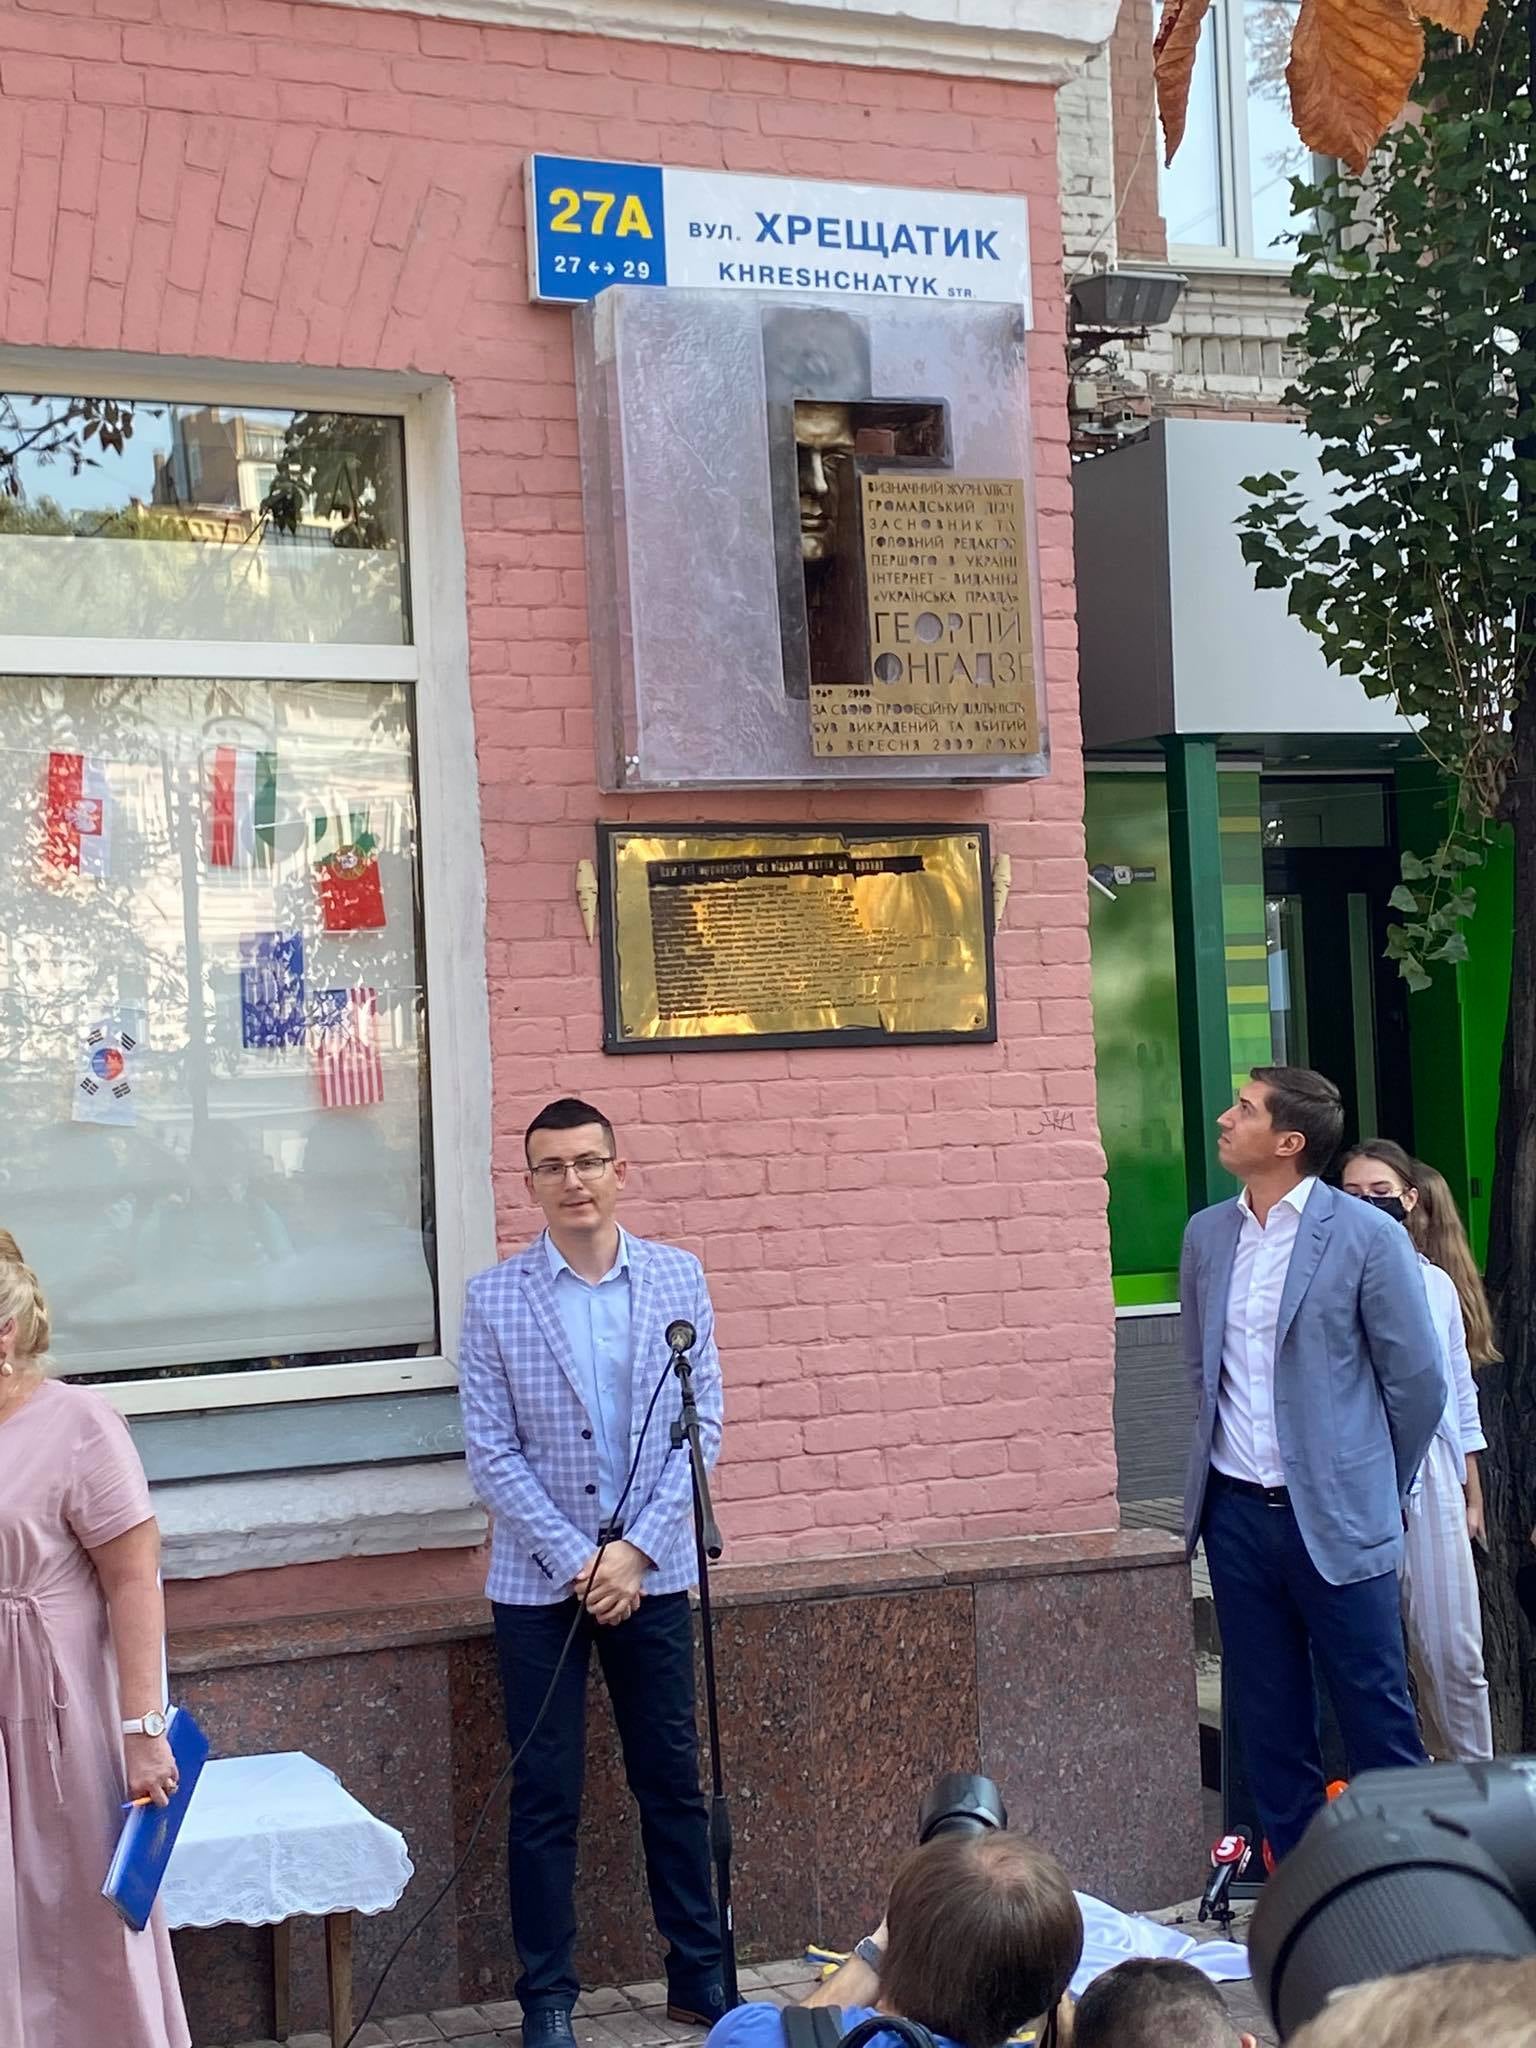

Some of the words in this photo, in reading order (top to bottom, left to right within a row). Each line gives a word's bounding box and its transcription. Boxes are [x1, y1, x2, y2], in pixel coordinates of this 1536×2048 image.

[548, 188, 653, 239] 27А
[689, 223, 741, 241] ВУЛ.
[755, 211, 1000, 260] ХРЕЩАТИК
[554, 256, 580, 273] 27
[623, 261, 650, 279] 29
[719, 263, 937, 295] KHRESHCHATYK
[868, 482, 943, 495] ВИЗНАЧНИЙ
[868, 500, 974, 514] ГРОМАДСЬКИЙ
[870, 519, 983, 531] ЗАСНОВНИК
[870, 536, 944, 548] ГОЛОВНИЙ
[872, 554, 937, 566] ПЕРШОГО
[873, 573, 933, 584] ІНТЕРНЕТ
[875, 606, 1021, 643] ГЕОРГІЙ
[813, 705, 826, 715] ЗА
[849, 720, 938, 734] ВИКРАДЕНИЙ
[848, 739, 920, 751] ВЕРЕСНЯ
[1216, 1836, 1238, 1856] 5
